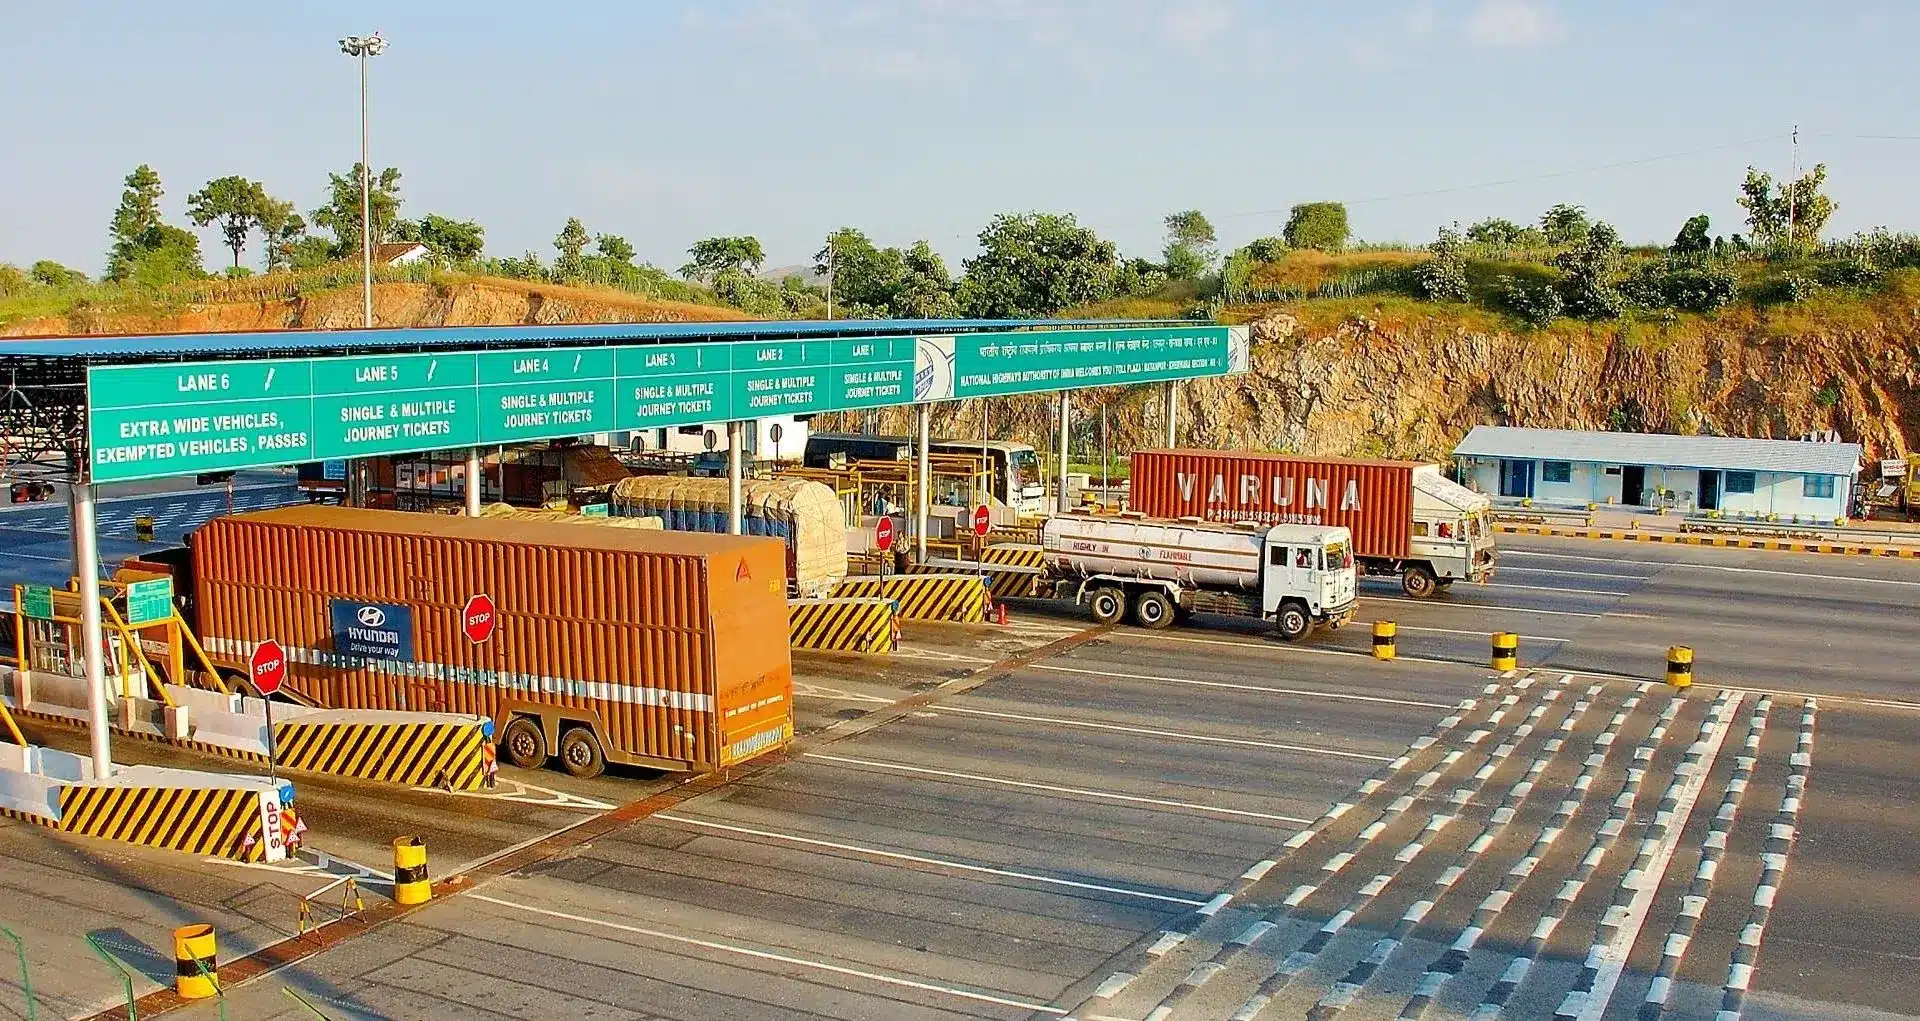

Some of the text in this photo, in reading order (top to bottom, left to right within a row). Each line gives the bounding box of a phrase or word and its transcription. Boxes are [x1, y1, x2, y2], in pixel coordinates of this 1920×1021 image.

[756, 348, 783, 361] LANE 2
[852, 344, 874, 357] LANE 1
[513, 358, 549, 374] LANE 4
[645, 352, 676, 367] LANE 3
[355, 365, 398, 382] LANE 5
[844, 372, 867, 384] SINGLE
[867, 371, 873, 383] &
[873, 370, 903, 382] MULTIPLE
[960, 374, 992, 387] NATIONAL
[992, 372, 1022, 385] HIGHWAYS
[1022, 370, 1053, 382] AUTHORITY
[1053, 369, 1060, 379] OF
[1075, 366, 1102, 377] WELCOMES
[178, 374, 229, 391] LANE 6
[634, 382, 714, 400] SINGLE & MULTIPLE
[747, 375, 815, 391] SINGLE & MULTIPLE
[501, 391, 594, 410] SINGLE & MULTIPLE
[749, 391, 813, 408] JOURNEY TICKETS
[845, 385, 901, 399] JOURNEY TICKETS
[340, 399, 456, 422] SINGLE & MULTIPLE
[637, 399, 712, 417] JOURNEY TICKETS
[120, 420, 170, 438] EXTRA
[174, 416, 209, 434] WIDE
[504, 409, 592, 428] JOURNEY TICKETS
[344, 420, 450, 443] JOURNEY TICKETS
[97, 443, 175, 464] EXEMPTED
[258, 431, 307, 449] PASSES
[1177, 472, 1361, 511] VARUNA
[1072, 541, 1097, 552] HIGHLY
[1159, 549, 1192, 562] FLAMMABLE
[469, 612, 491, 626] STOP
[348, 626, 399, 645] HYUNDAI
[350, 642, 399, 658] Drive your way
[256, 658, 280, 676] STOP
[267, 800, 281, 850] STOP
